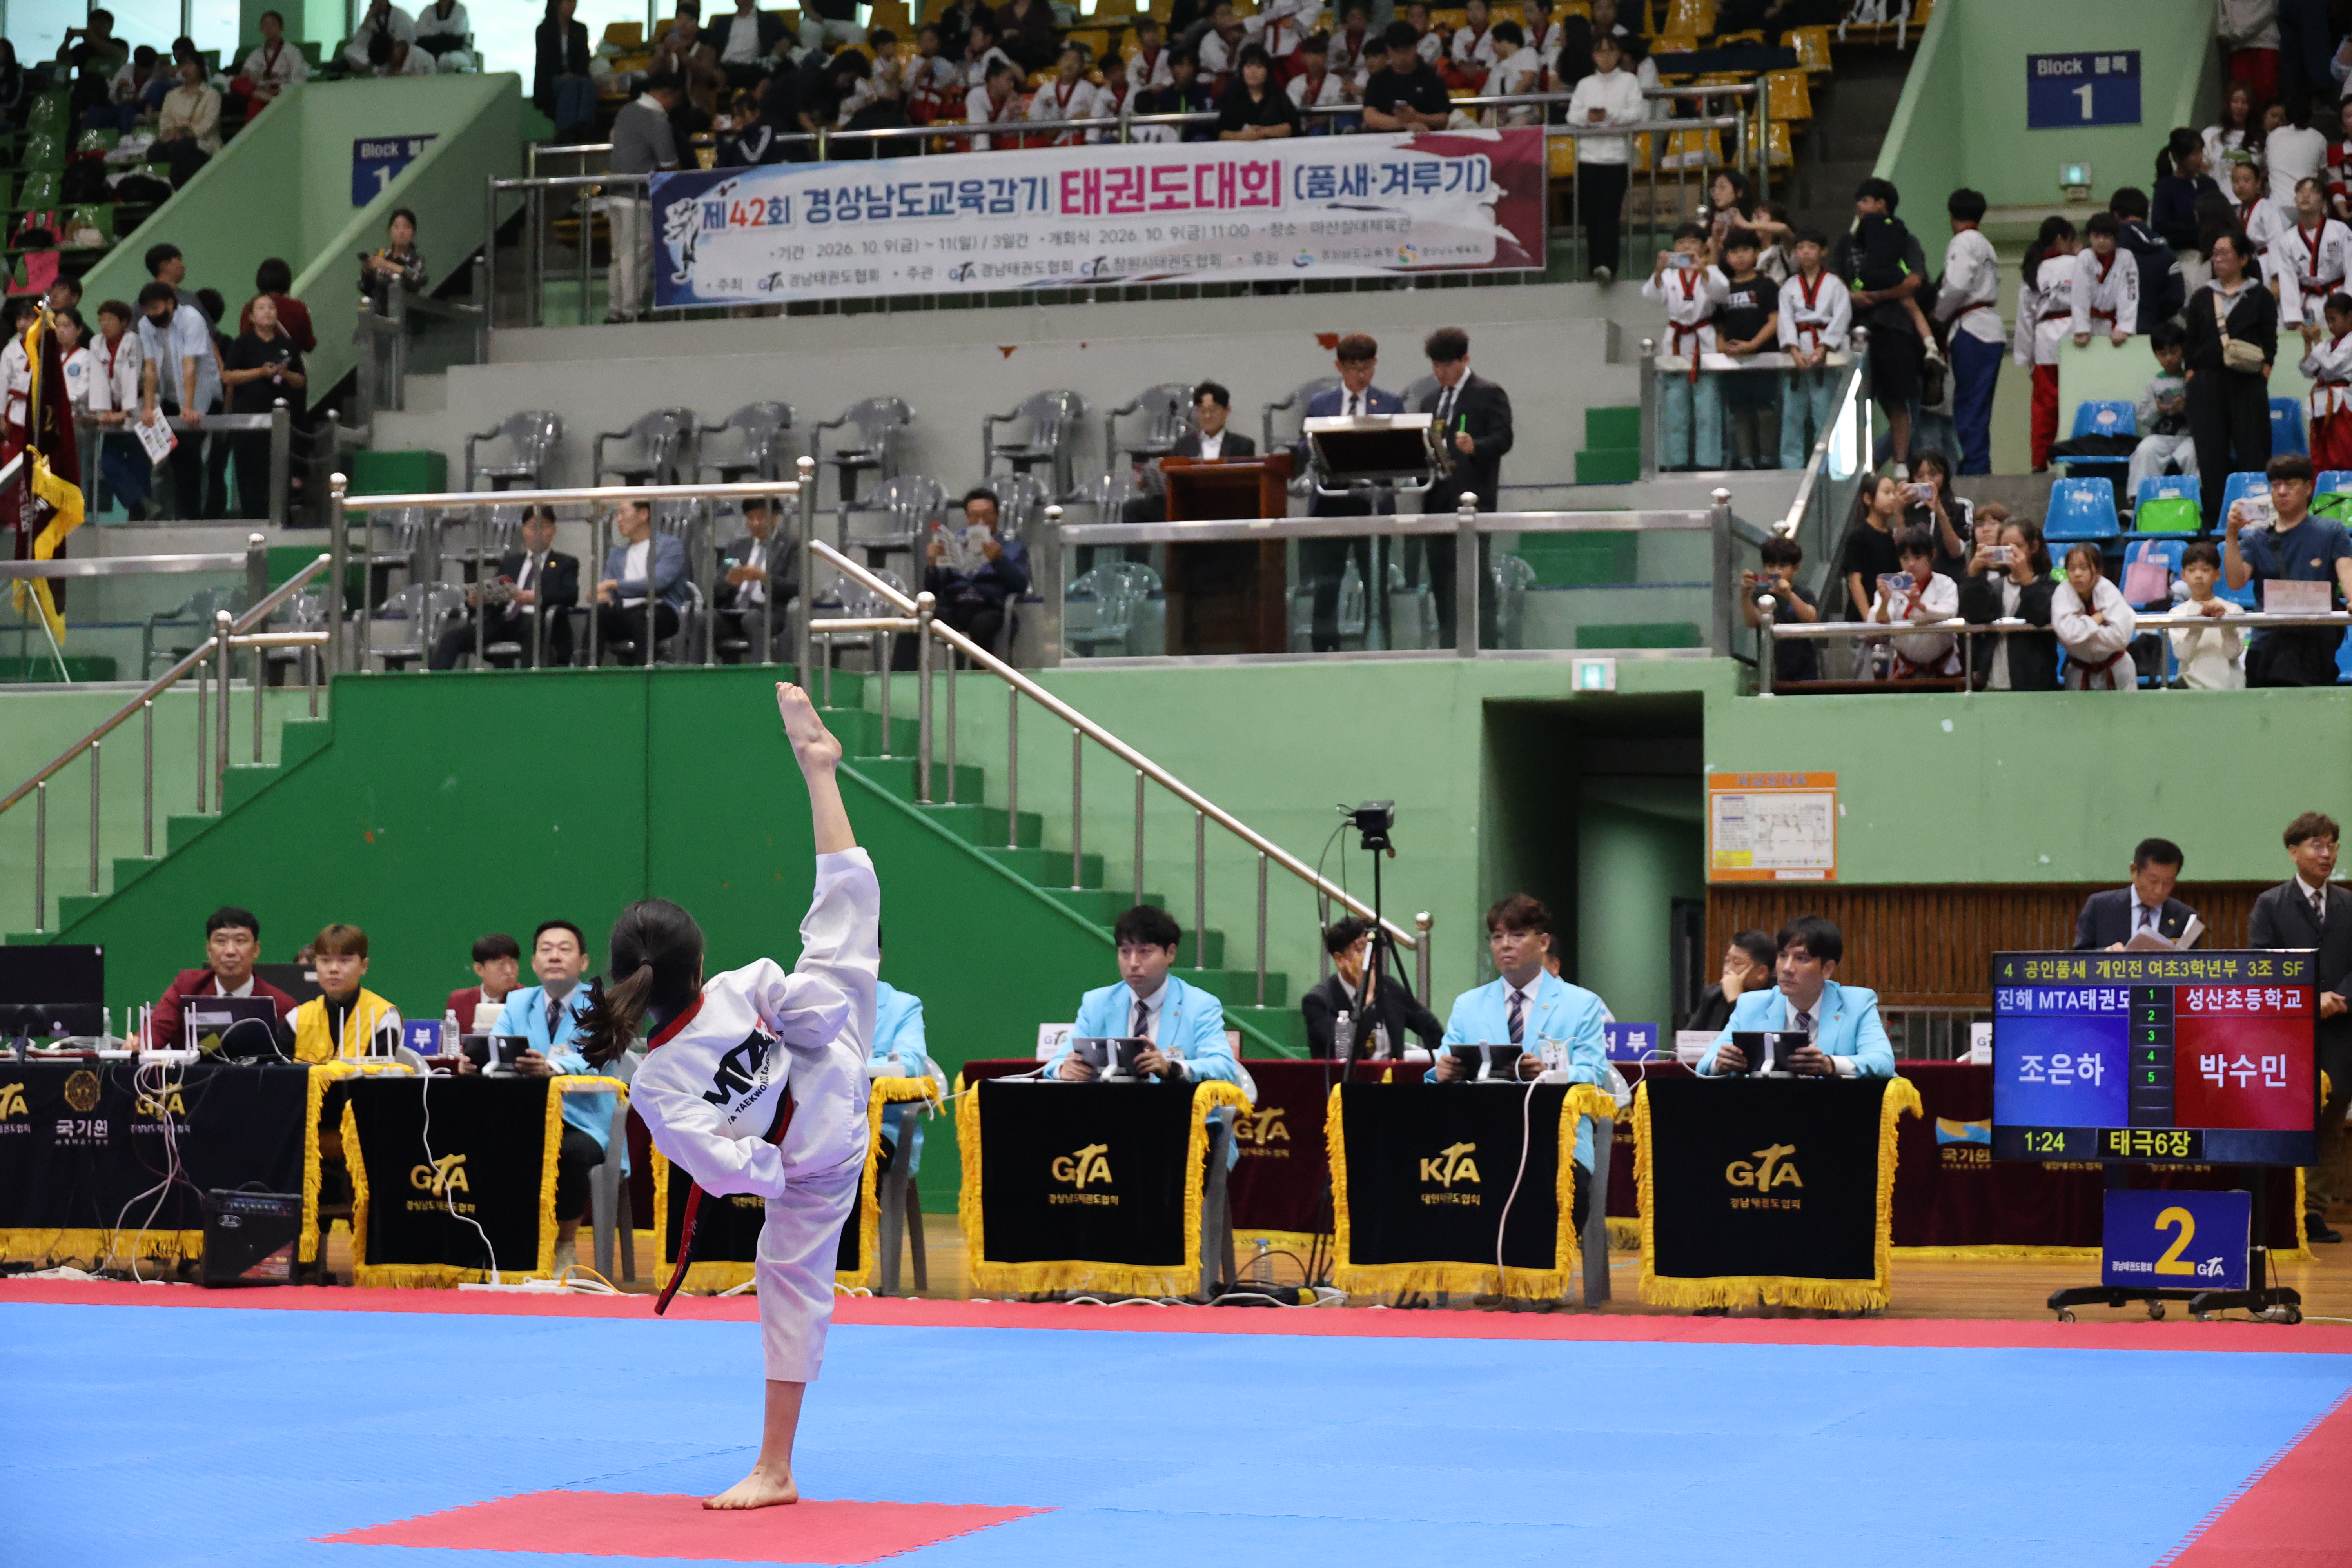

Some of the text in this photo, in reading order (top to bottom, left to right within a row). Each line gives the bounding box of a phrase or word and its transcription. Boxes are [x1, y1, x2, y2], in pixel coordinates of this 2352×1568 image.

[2037, 58, 2083, 76] Block
[2072, 83, 2093, 119] 1
[703, 196, 791, 229] 제42회
[803, 176, 1048, 225] 경상남도교육감기
[1060, 160, 1281, 215] 태권도대회
[2004, 958, 2304, 979] 4 공인품새 개인전 여초3학년부 3조 SF
[1997, 989, 2033, 1011] 진해
[2147, 989, 2155, 1000] 1
[2186, 989, 2303, 1011] 성산초등학교
[2147, 1010, 2155, 1021] 2
[2147, 1031, 2155, 1042] 3
[2147, 1050, 2155, 1061] 4
[2018, 1053, 2105, 1087] 조은하
[2147, 1071, 2155, 1082] 5
[2200, 1053, 2287, 1088] 박수민
[56, 1119, 109, 1137] 국기원
[1233, 1107, 1291, 1145] GTA
[2025, 1131, 2065, 1152] 1:24
[2110, 1131, 2192, 1158] 태극6장
[1052, 1143, 1112, 1189] GTA
[1420, 1142, 1481, 1188] KTA
[1941, 1147, 1992, 1163] 국기원
[410, 1153, 470, 1197] GTA
[1726, 1143, 1804, 1192] GTA
[2154, 1206, 2195, 1276] 2
[2196, 1256, 2225, 1278] GTA
